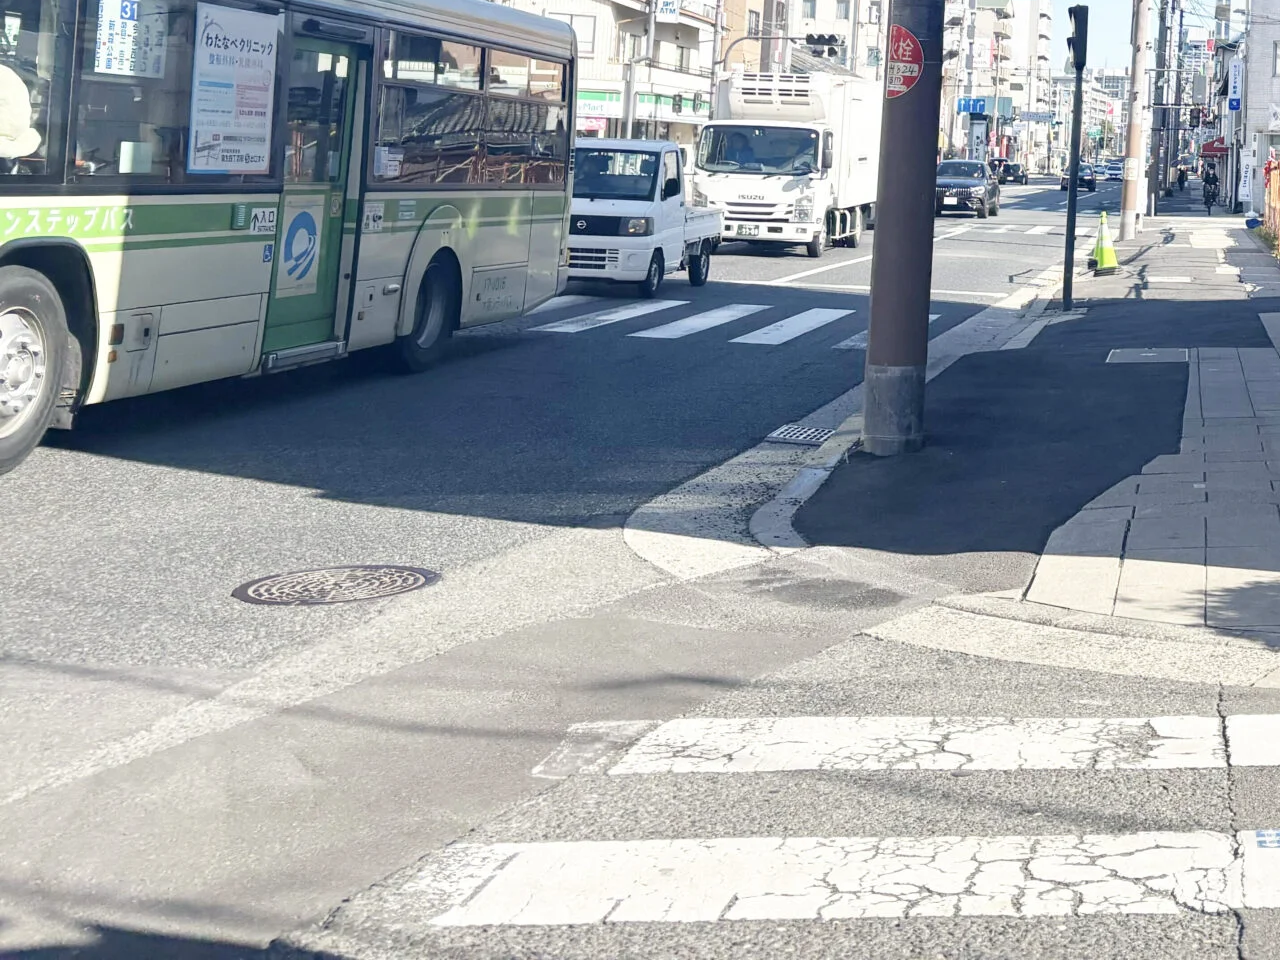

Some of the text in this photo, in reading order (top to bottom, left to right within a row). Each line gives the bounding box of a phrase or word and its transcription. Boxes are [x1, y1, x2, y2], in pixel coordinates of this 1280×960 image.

[121, 1, 138, 20] 31
[659, 7, 676, 15] ATM
[205, 33, 274, 56] わたなべクリニック
[4, 208, 133, 234] ンステップバス
[260, 210, 275, 224] 入口
